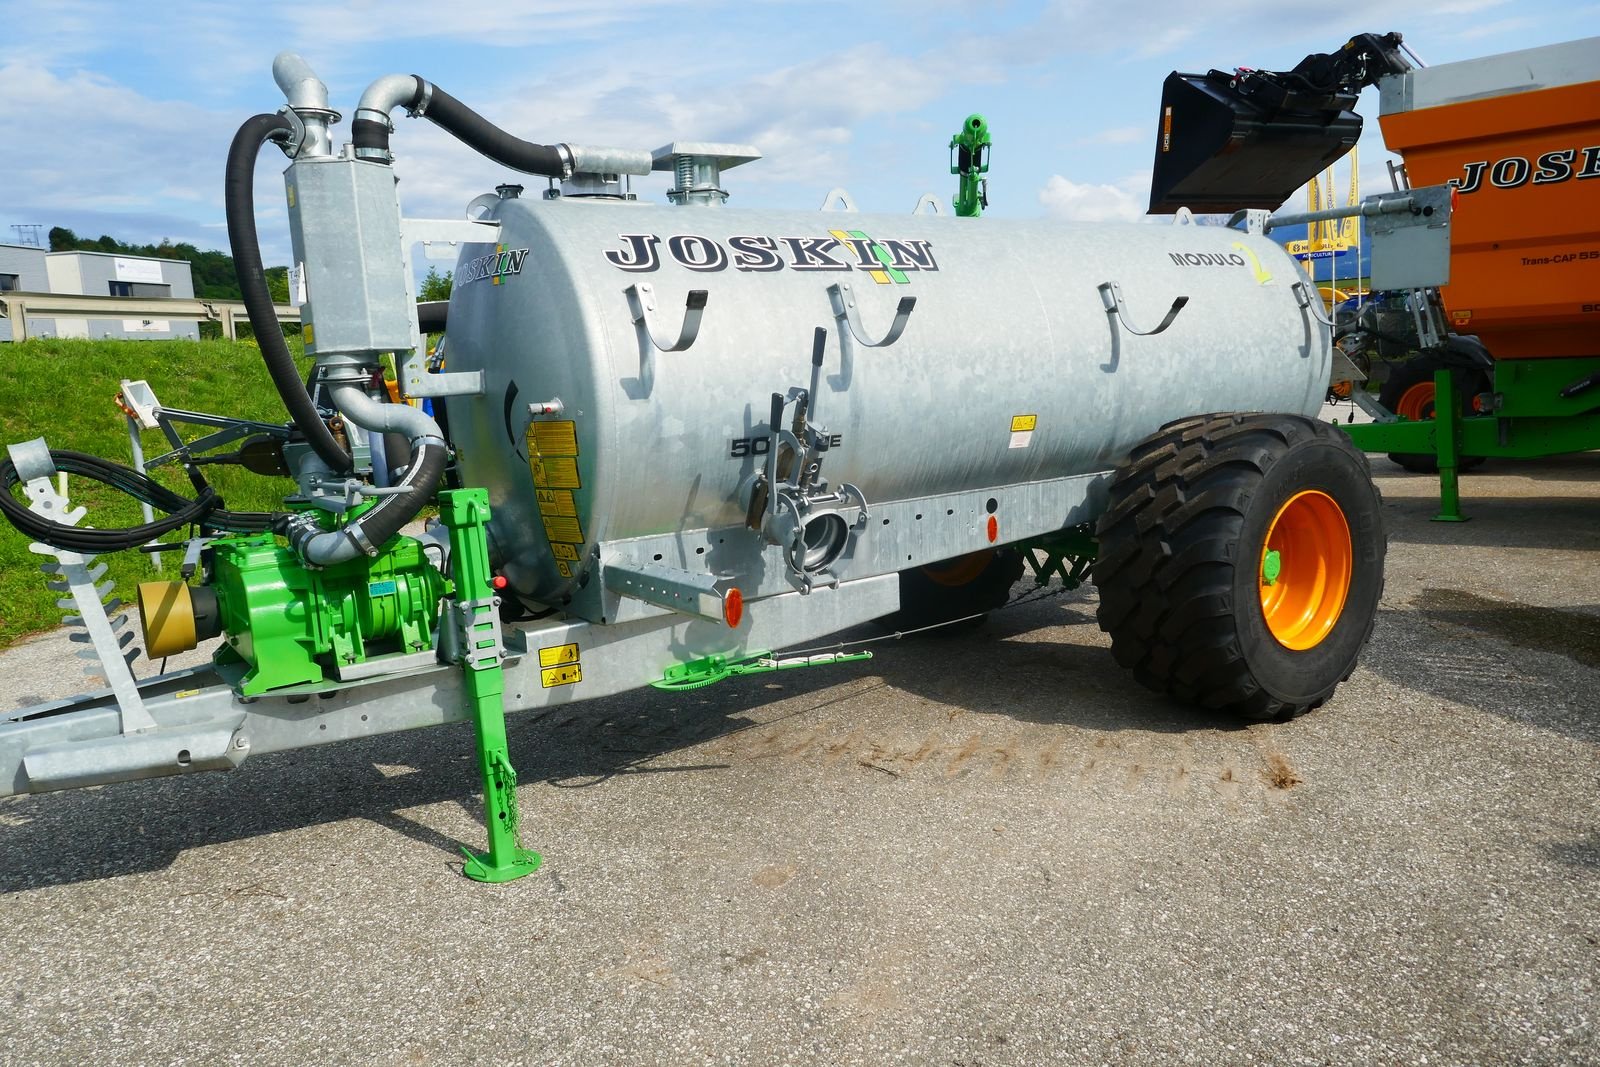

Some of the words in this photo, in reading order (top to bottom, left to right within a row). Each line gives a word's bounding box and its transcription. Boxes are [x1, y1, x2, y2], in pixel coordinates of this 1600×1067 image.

[602, 233, 939, 272] JOSKIN
[1167, 252, 1245, 267] MODULO
[1521, 254, 1577, 267] Trans-CAP
